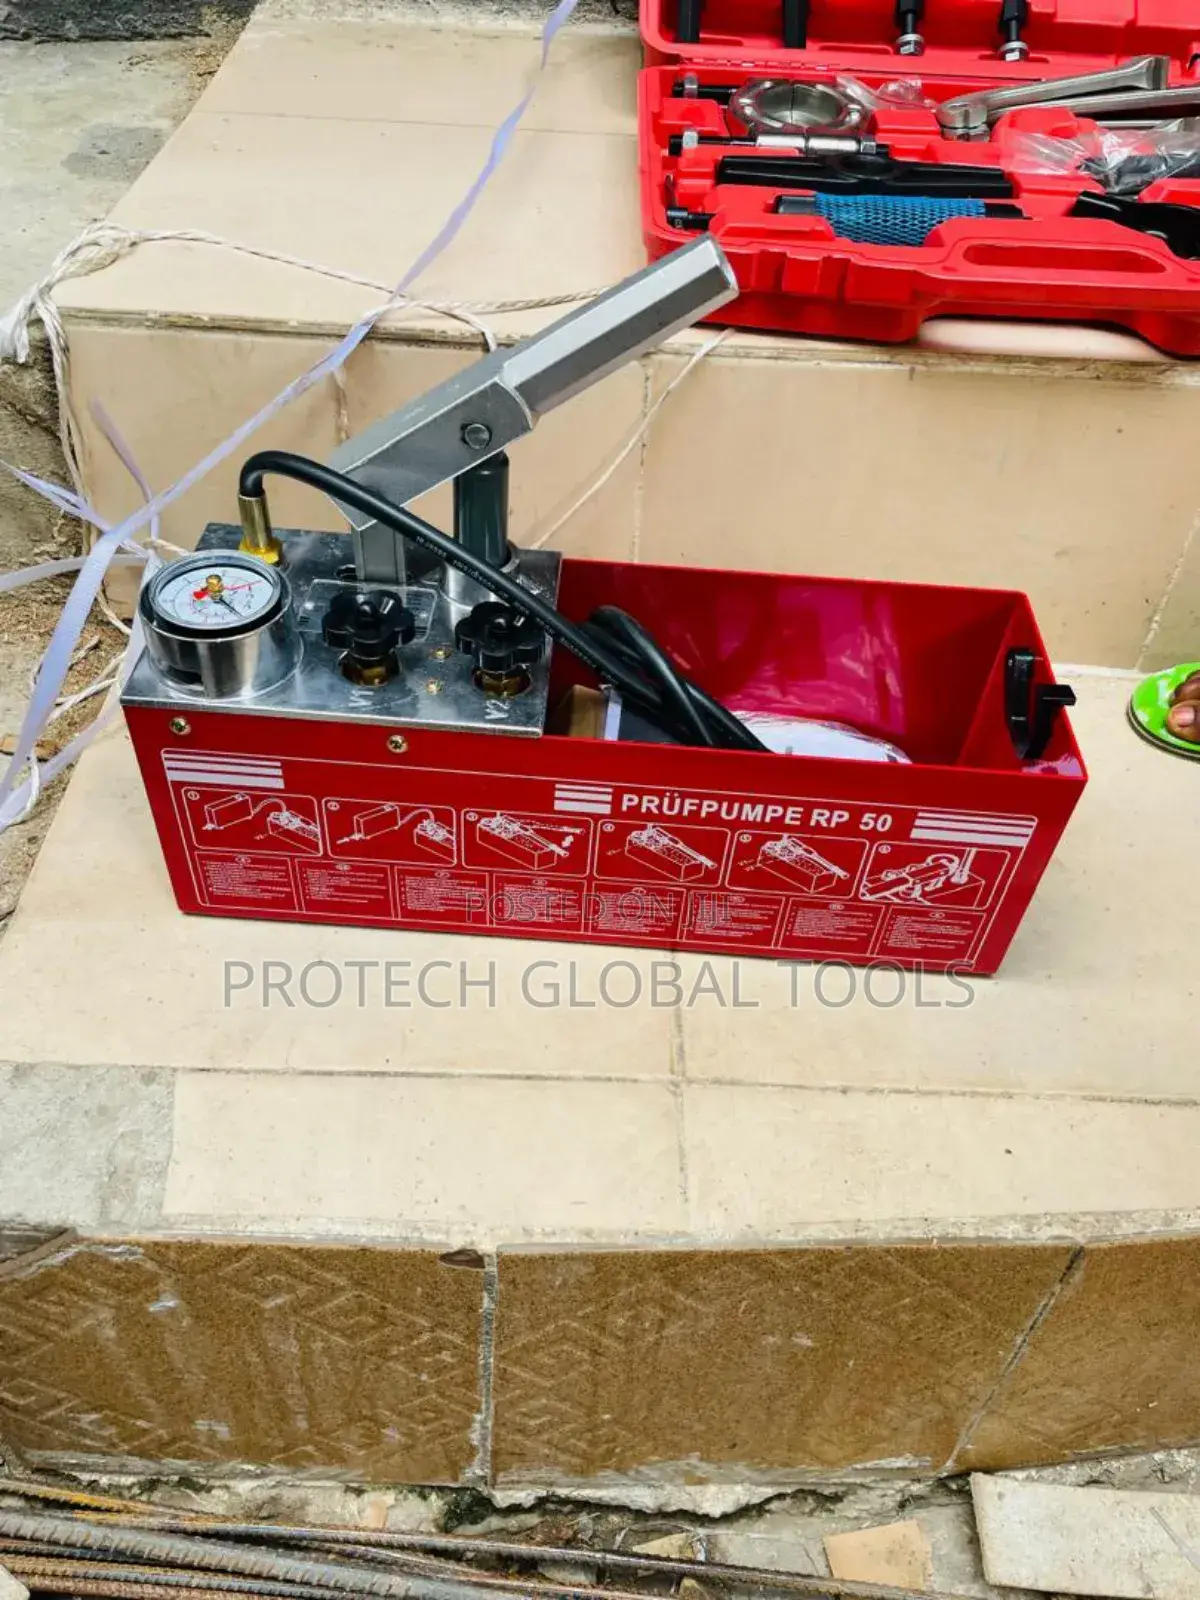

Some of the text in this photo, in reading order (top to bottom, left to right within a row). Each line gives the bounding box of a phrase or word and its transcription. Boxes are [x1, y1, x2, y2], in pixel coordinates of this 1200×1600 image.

[484, 699, 511, 720] V2
[621, 791, 893, 833] PRÜFPUMPE RP 50
